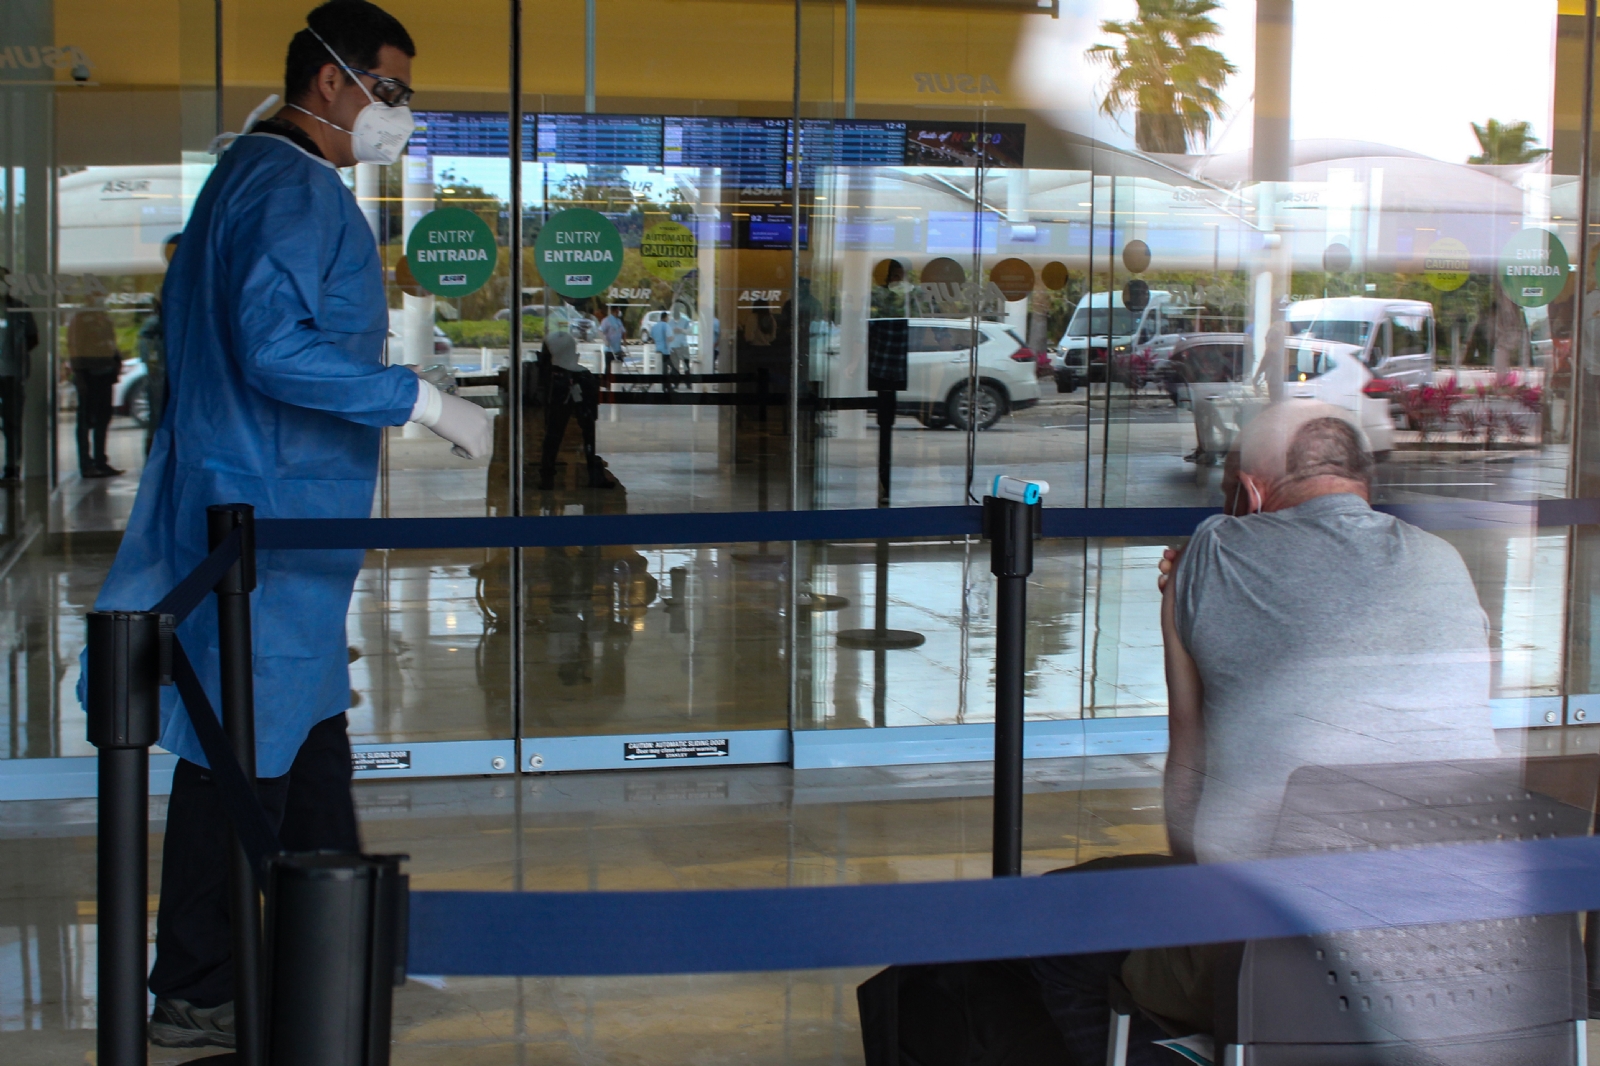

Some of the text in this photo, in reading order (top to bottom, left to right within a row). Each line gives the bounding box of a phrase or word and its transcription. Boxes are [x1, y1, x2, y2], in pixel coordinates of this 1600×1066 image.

[640, 116, 661, 124] 12:43
[764, 119, 786, 127] 12:43
[885, 121, 907, 130] 12:43
[102, 181, 152, 193] ASUR
[750, 214, 763, 222] 92
[428, 230, 476, 243] ENTRY
[556, 231, 601, 244] ENTRY
[645, 233, 693, 242] AUTOMATIC
[417, 249, 488, 262] ENTRADA
[544, 250, 613, 262] ENTRADA
[642, 245, 694, 256] CAUTION
[1517, 249, 1552, 259] ENTRY
[1425, 259, 1469, 269] CAUTION
[1506, 265, 1561, 276] ENTRADA
[607, 288, 651, 299] ASUR
[739, 290, 781, 301] ASUR
